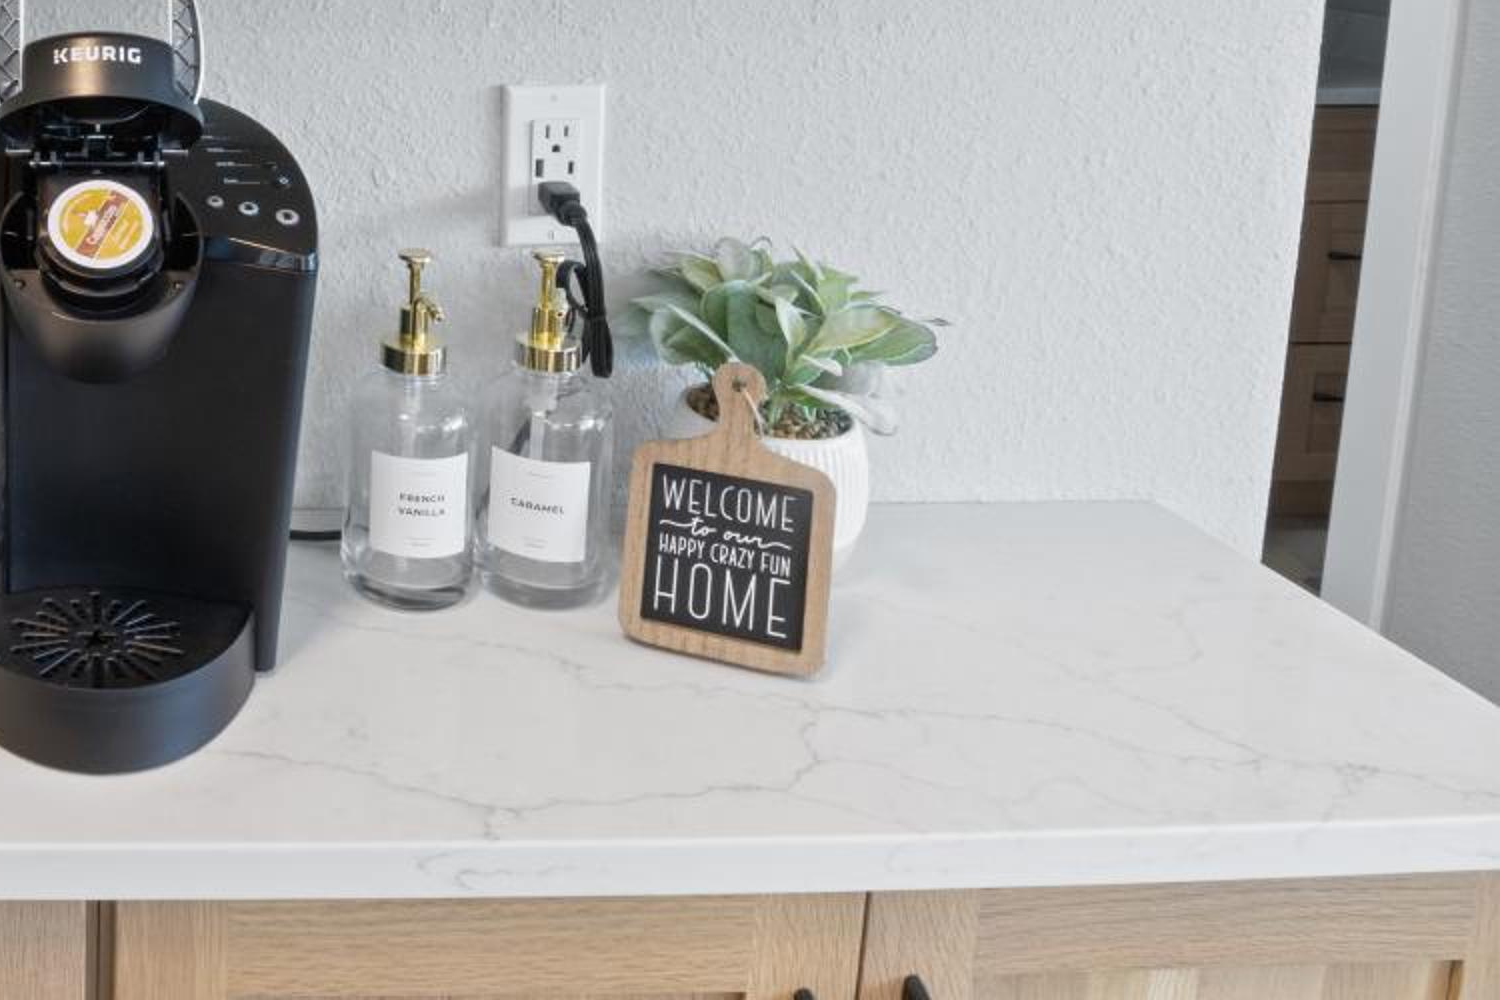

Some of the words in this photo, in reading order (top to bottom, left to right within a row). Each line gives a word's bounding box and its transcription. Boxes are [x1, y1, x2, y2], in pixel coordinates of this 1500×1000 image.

[53, 45, 142, 65] KEURIG
[510, 497, 565, 515] CARAMEL
[663, 473, 795, 533] WELCOME
[659, 533, 706, 560] HAPPY
[710, 543, 754, 569] CRAZY
[760, 552, 791, 578] FUN
[723, 530, 792, 551] our
[653, 555, 791, 639] HOME
